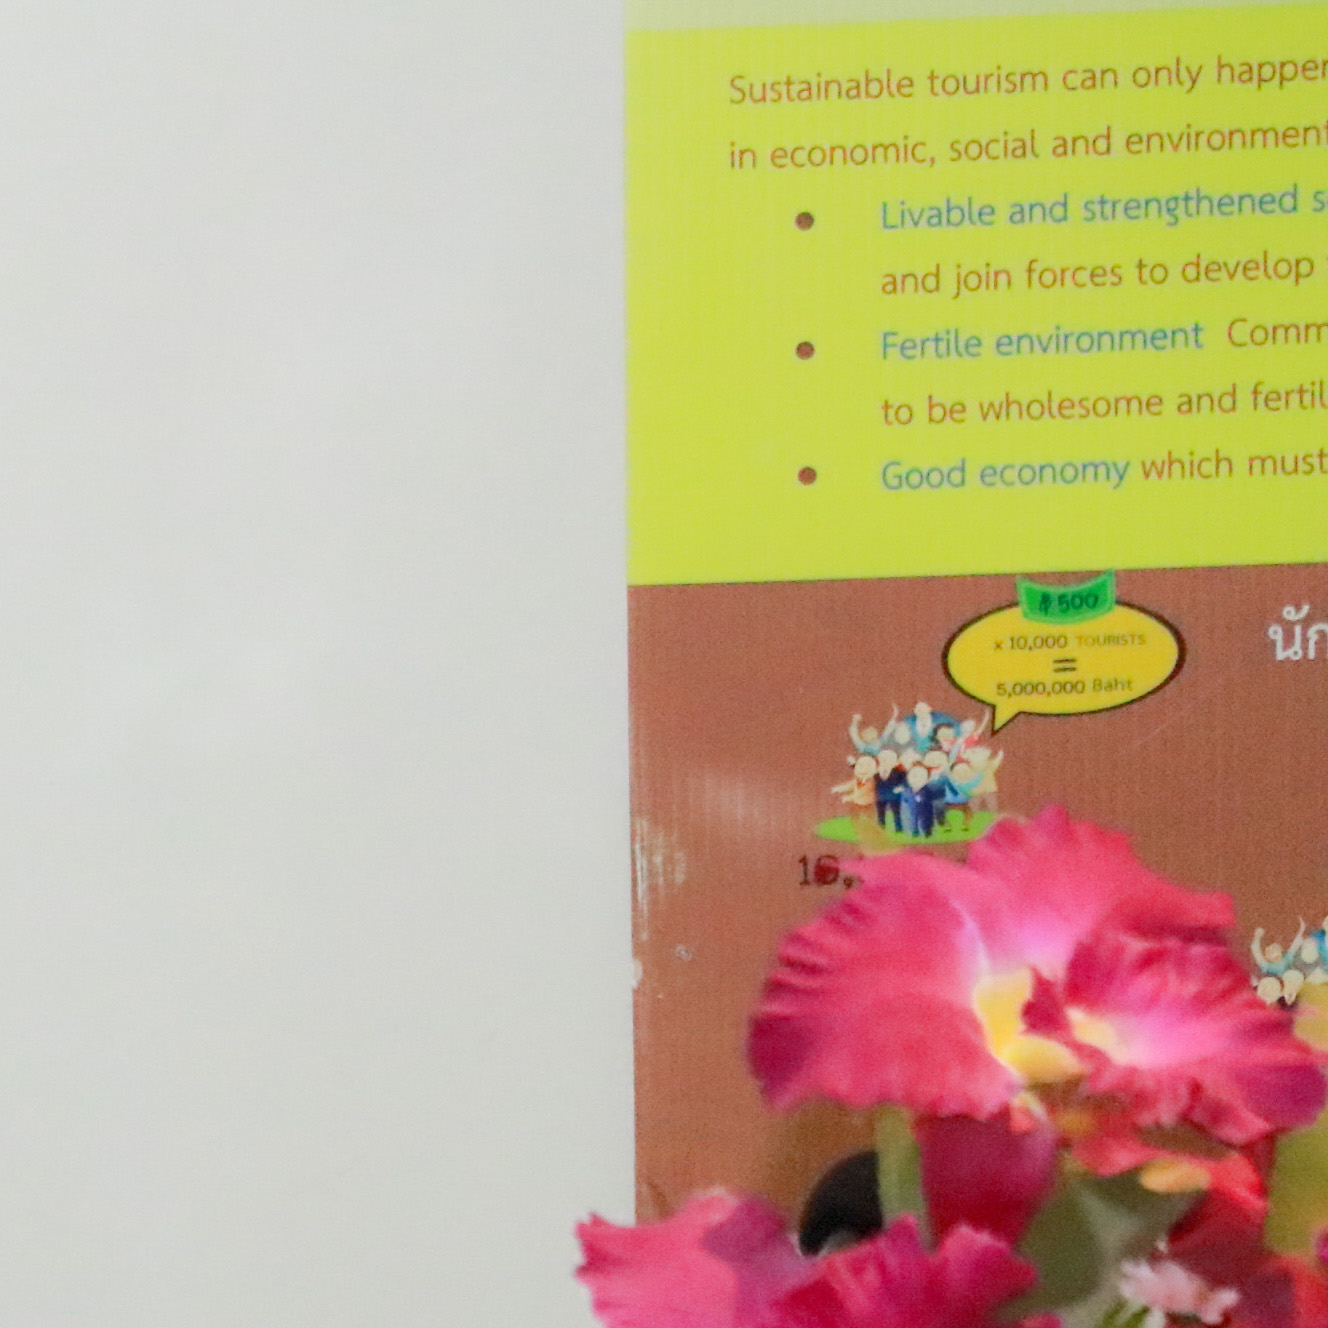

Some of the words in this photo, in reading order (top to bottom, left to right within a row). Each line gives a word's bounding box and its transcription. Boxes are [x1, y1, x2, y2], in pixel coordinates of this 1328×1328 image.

[729, 68, 915, 105] Sustainable
[927, 65, 1049, 97] tourism
[1061, 67, 1119, 92] can
[1132, 56, 1203, 94] only
[729, 141, 757, 170] in
[769, 134, 936, 170] economic,
[949, 128, 1040, 162] social
[1051, 125, 1112, 159] and
[881, 196, 996, 231] Livable
[1008, 192, 1069, 225] and
[1082, 183, 1299, 228] strengthened
[880, 263, 941, 296] and
[953, 262, 1013, 299] join
[1025, 258, 1123, 290] forces
[1135, 257, 1169, 286] to
[1180, 250, 1315, 286] develop
[881, 328, 983, 361] Fertile
[994, 322, 1204, 357] environment
[880, 399, 914, 427] to
[927, 394, 967, 424] be
[978, 390, 1164, 422] wholesome
[1176, 383, 1238, 416] and
[881, 458, 967, 492] Good
[978, 460, 1131, 490] economy
[1140, 449, 1234, 481] which
[1009, 634, 1069, 652] 10,000
[1074, 632, 1147, 648] TOURISTS
[996, 681, 1086, 697] 5,000,000
[1092, 676, 1134, 693] Baht
